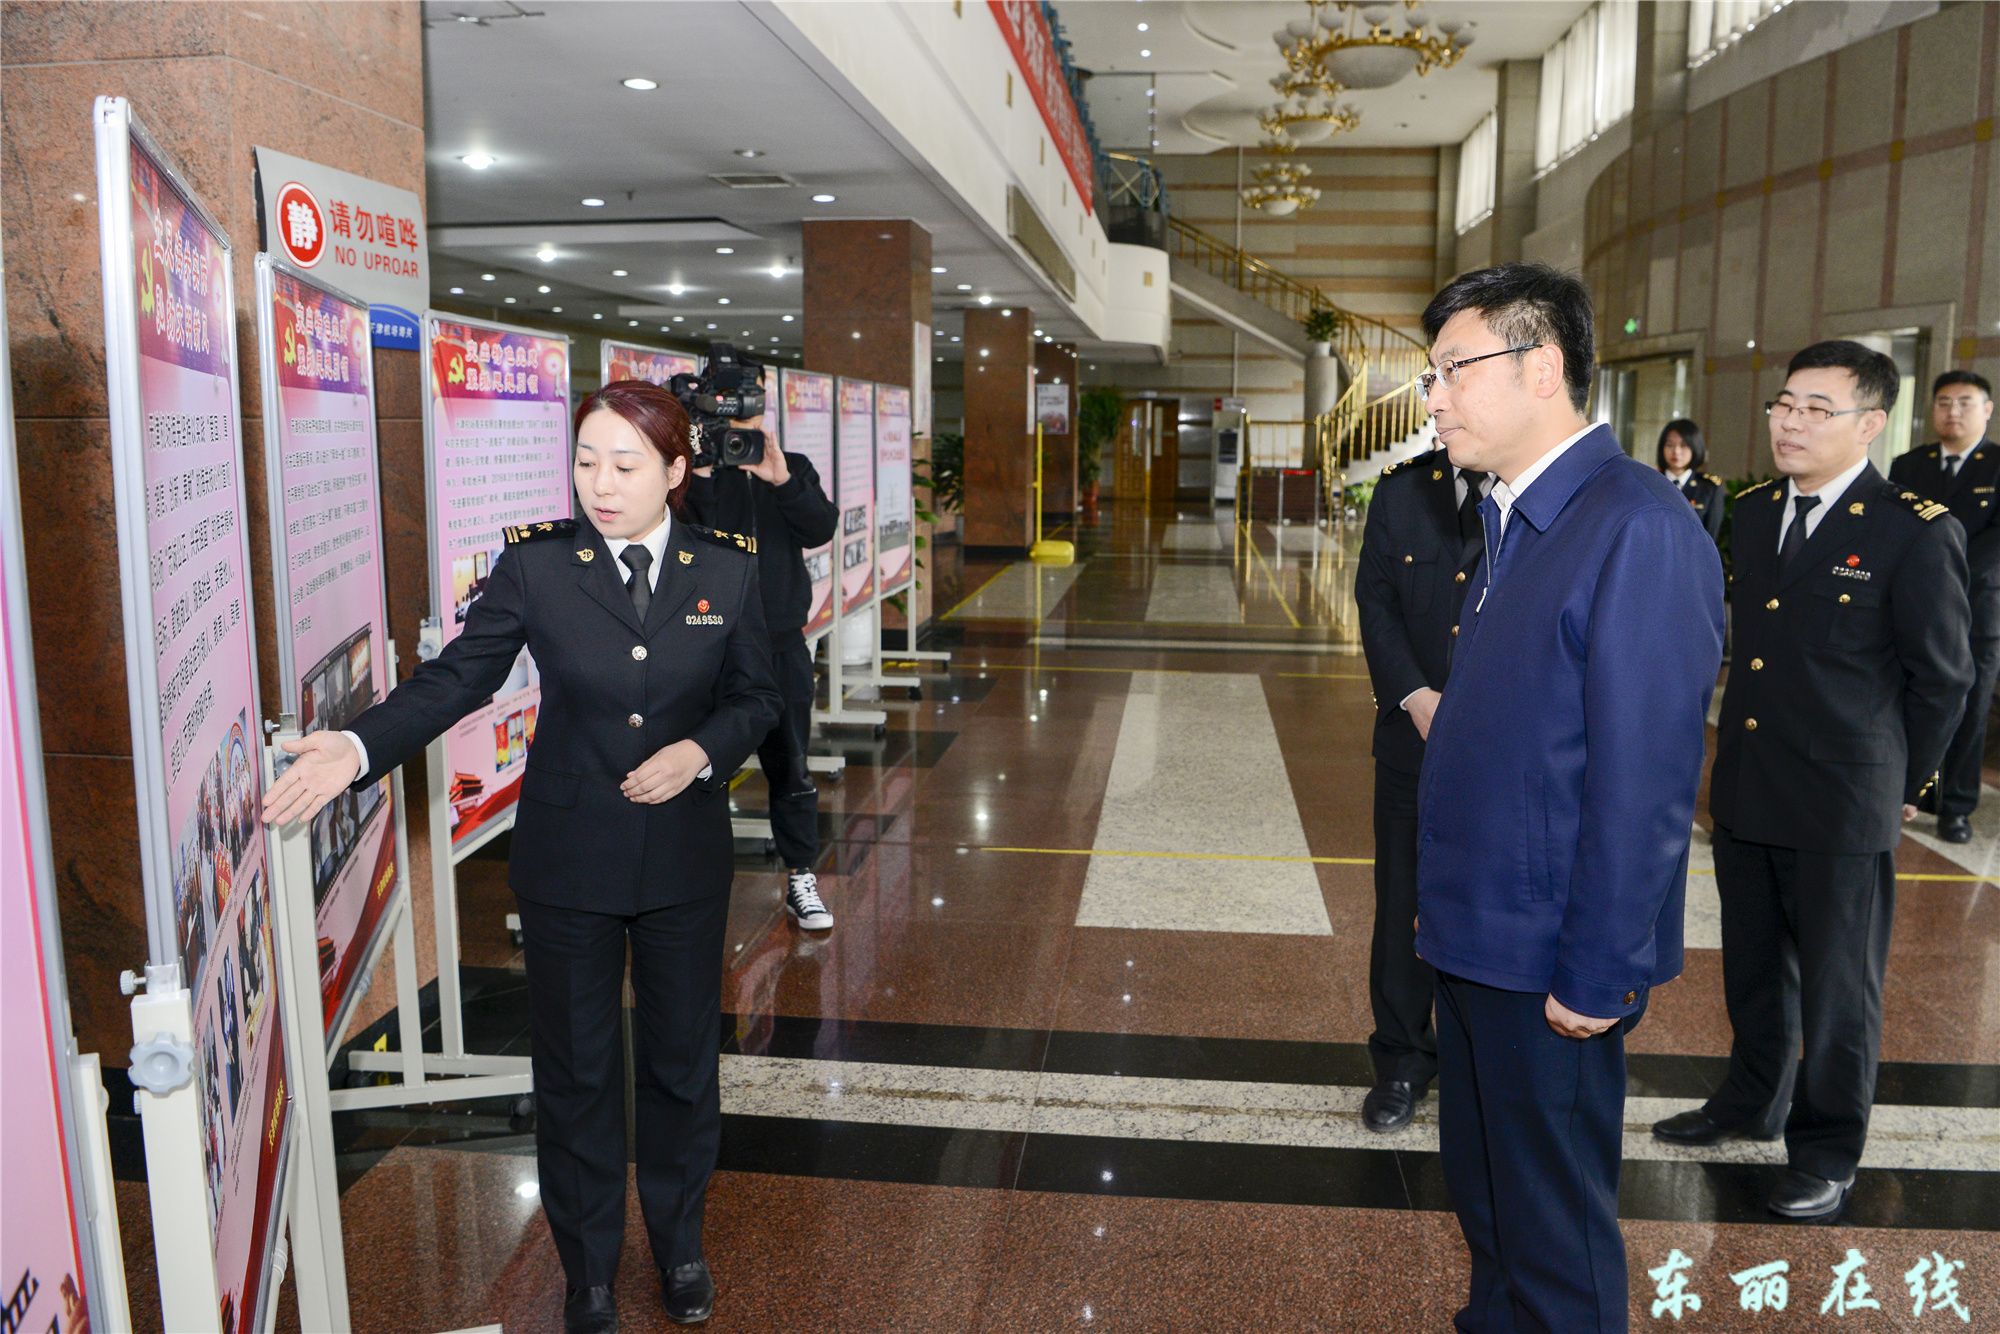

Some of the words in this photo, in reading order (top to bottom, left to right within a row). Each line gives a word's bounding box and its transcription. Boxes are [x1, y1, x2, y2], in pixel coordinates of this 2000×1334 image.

[287, 200, 318, 250] 静
[329, 199, 418, 253] 请勿喧哗
[335, 246, 357, 266] NO
[364, 252, 419, 278] UPROAR
[156, 283, 210, 355] 弘扬文明新风
